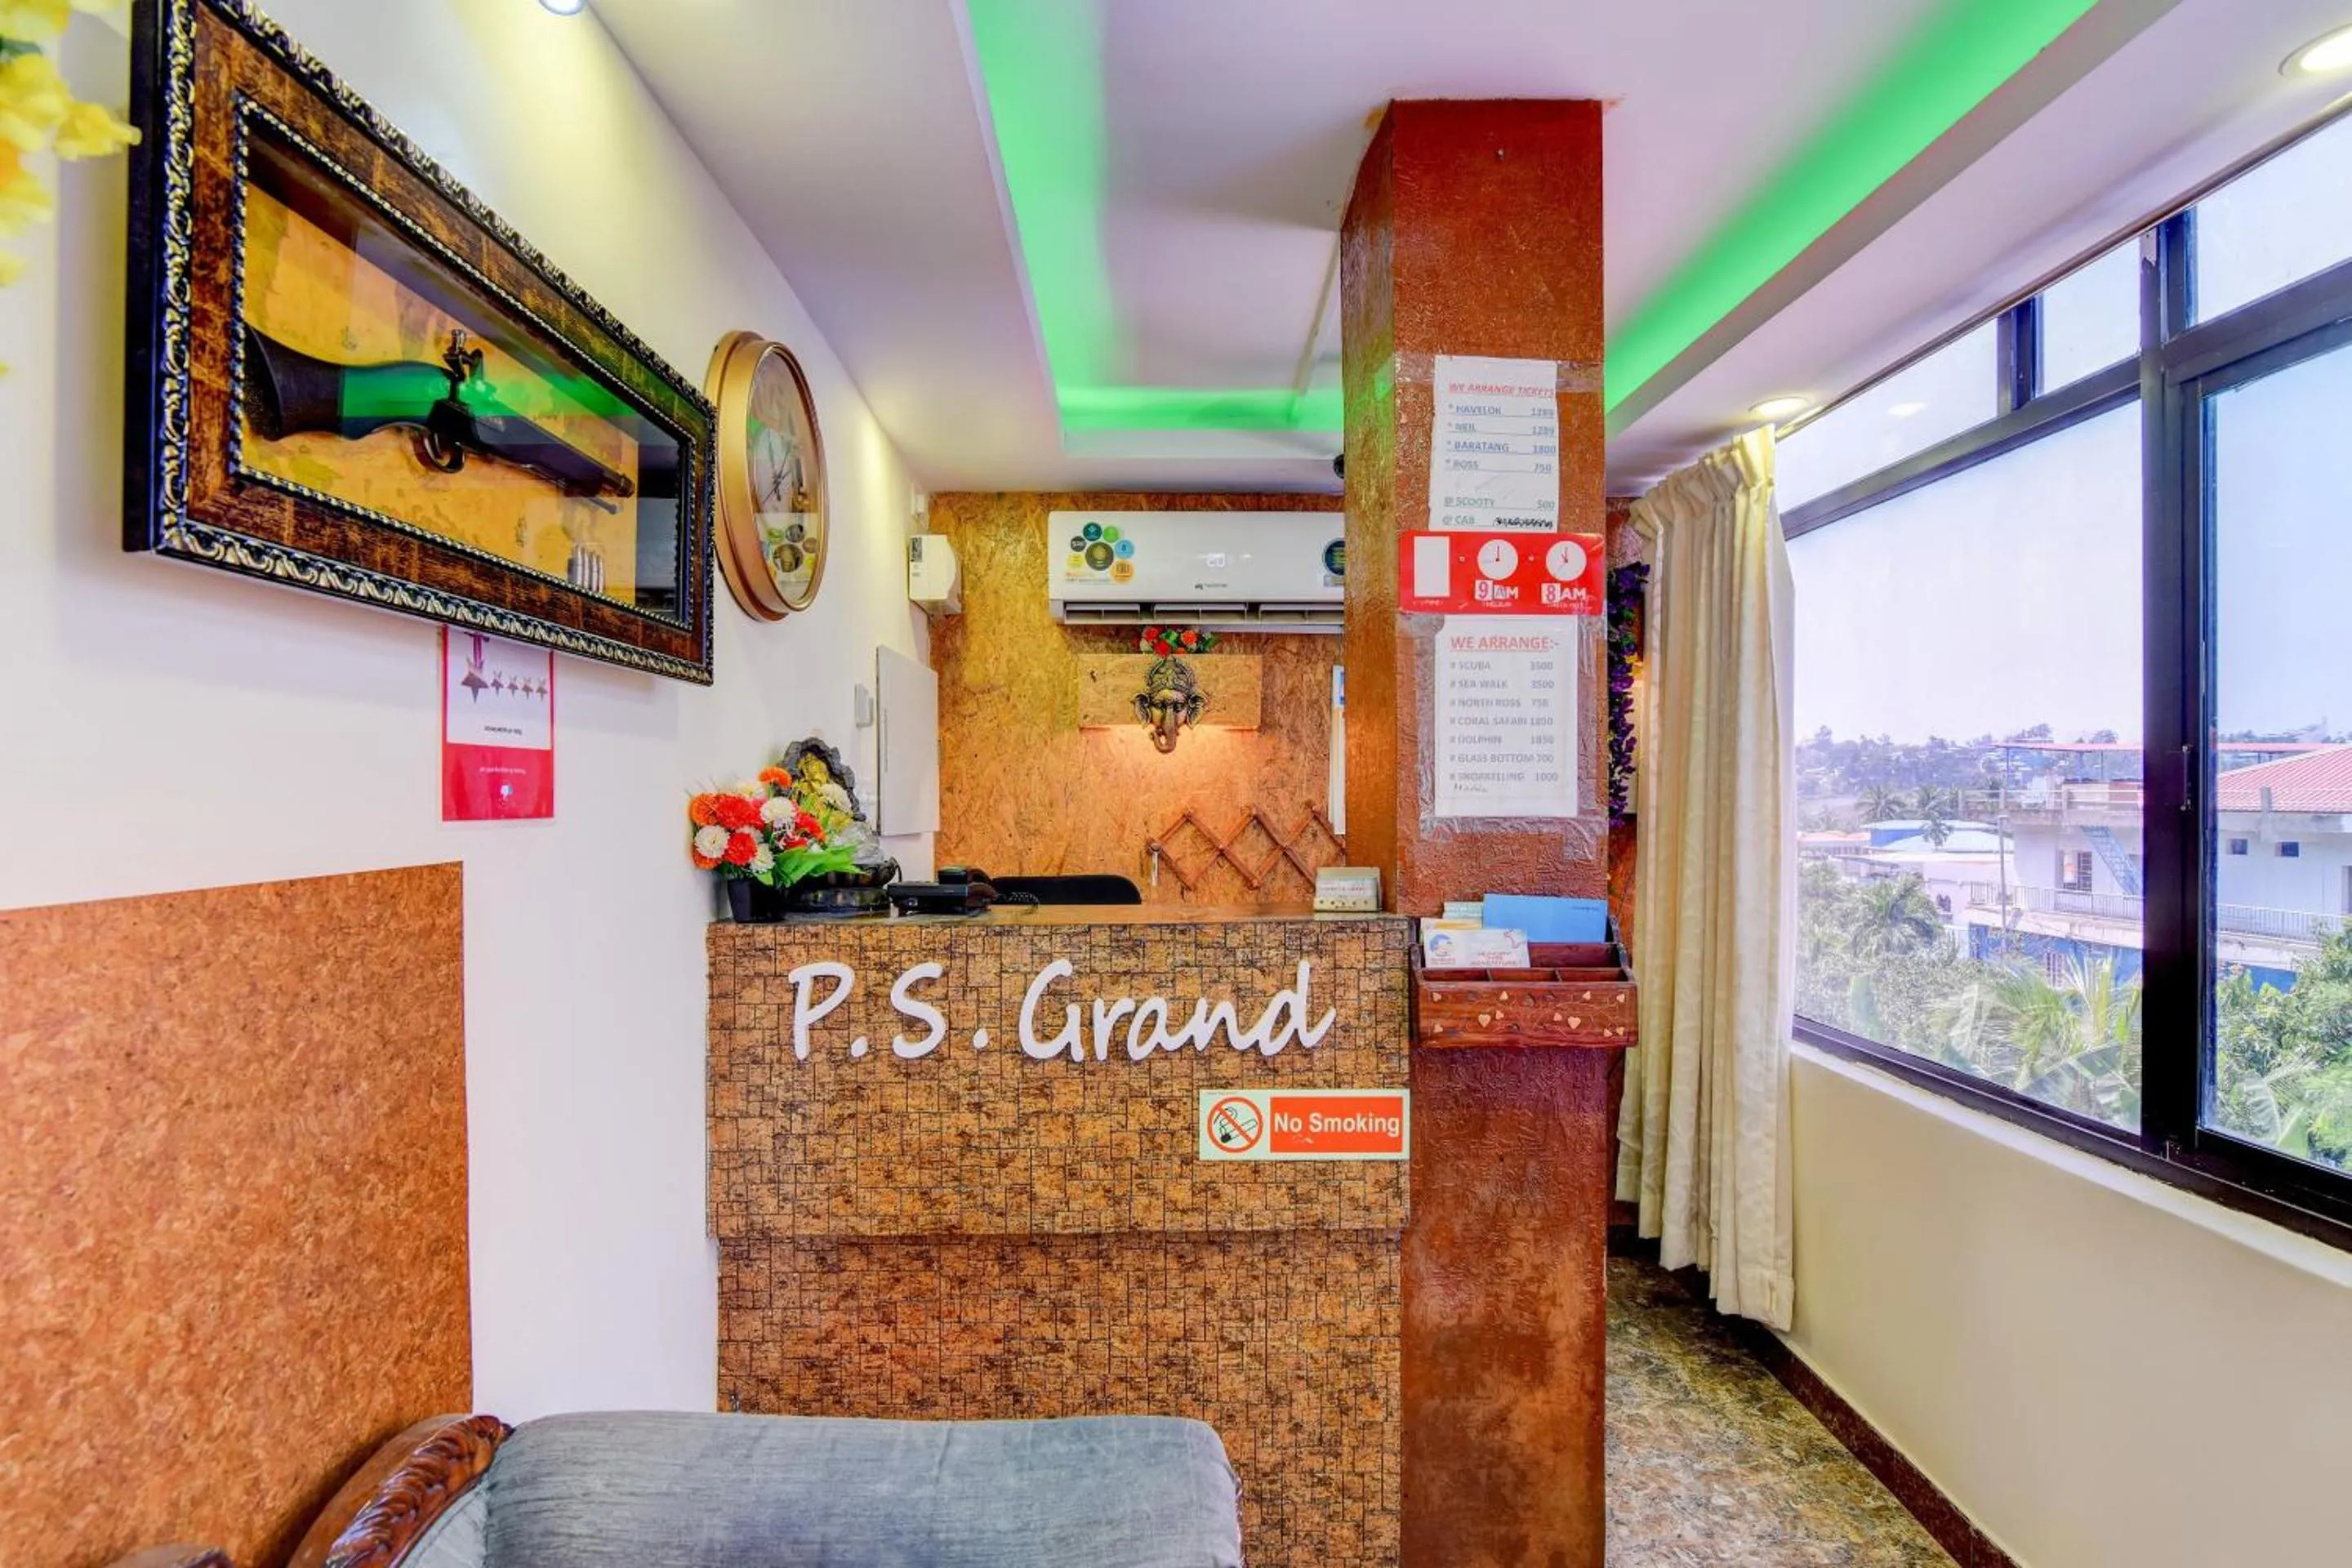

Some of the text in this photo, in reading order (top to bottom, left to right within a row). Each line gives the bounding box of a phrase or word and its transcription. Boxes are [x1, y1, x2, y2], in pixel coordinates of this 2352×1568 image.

[1455, 423, 1477, 433] NEIL
[1454, 441, 1509, 452] BARATANG
[1535, 464, 1552, 473] 750
[1455, 497, 1494, 507] SCOOTY
[1536, 500, 1555, 510] 500
[1455, 516, 1475, 524] CAB
[1451, 636, 1477, 649] WE
[1459, 662, 1490, 670] SCUBA
[1458, 680, 1476, 688] SEA
[1480, 680, 1508, 688] WALK
[1458, 699, 1494, 708] NORTH
[1495, 699, 1521, 707] ROSS
[1458, 717, 1490, 726] CORAL
[1458, 736, 1502, 745] DOLPHIN
[1458, 754, 1488, 763] GLASS
[1491, 754, 1534, 763] BOTTOM
[1536, 773, 1558, 782] 1000
[1019, 959, 1336, 1062] Grand
[1275, 1112, 1399, 1137] No Smoking
